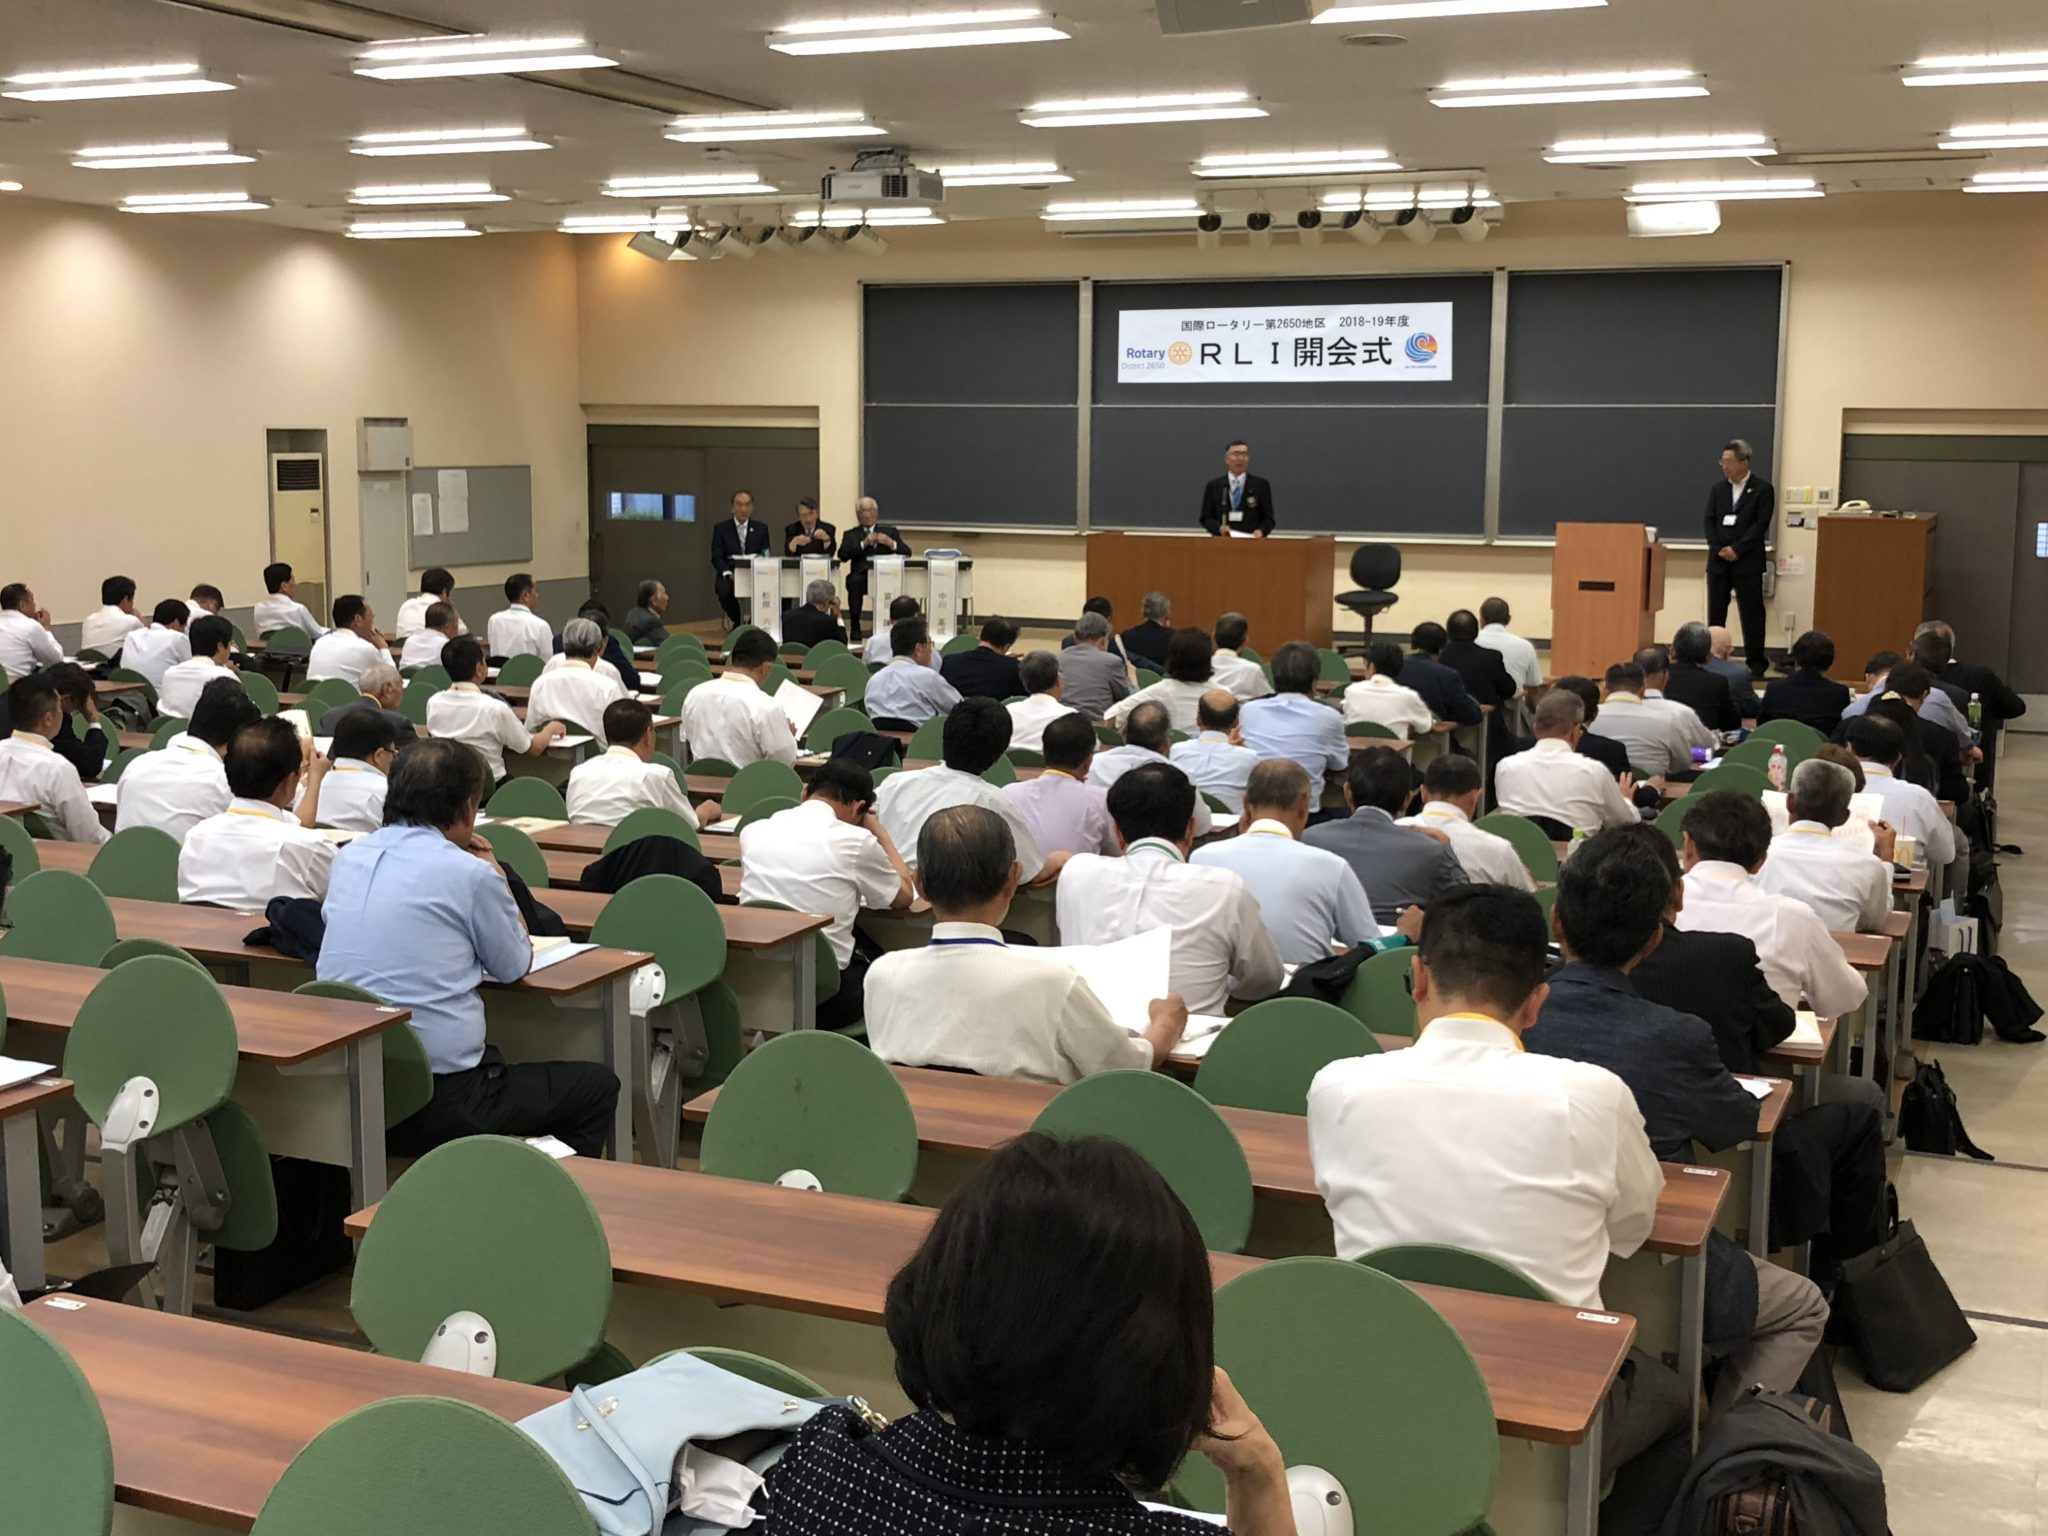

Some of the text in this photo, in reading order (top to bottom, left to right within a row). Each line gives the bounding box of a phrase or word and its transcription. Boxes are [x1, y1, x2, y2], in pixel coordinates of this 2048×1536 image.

[1181, 315, 1410, 331] 国際ロータリー第2650地区 2018-19年度
[1126, 347, 1165, 360] Rotary
[1121, 362, 1165, 370] District 2650
